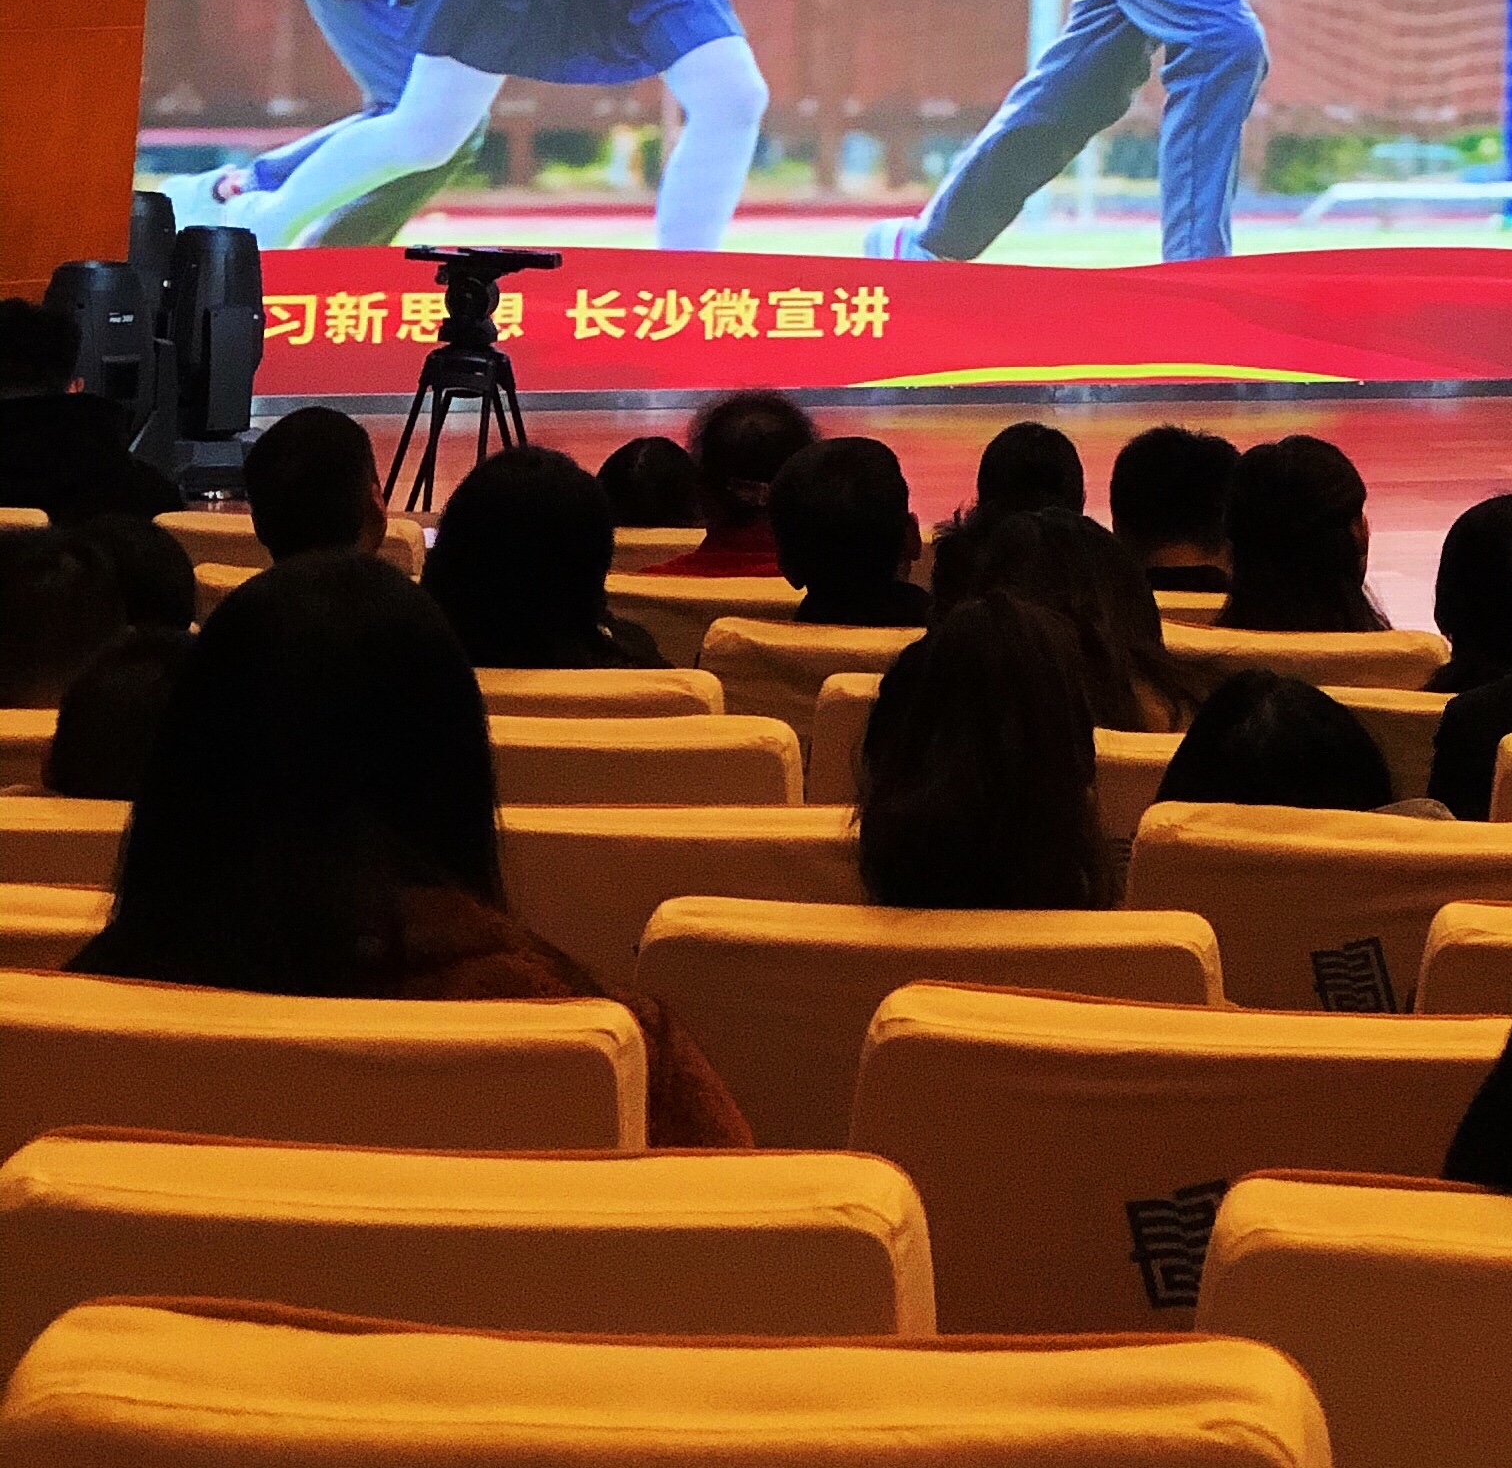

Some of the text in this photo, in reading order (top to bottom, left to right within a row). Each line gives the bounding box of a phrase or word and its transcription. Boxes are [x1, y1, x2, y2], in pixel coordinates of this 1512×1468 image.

[565, 286, 890, 341] 长沙微宣讲
